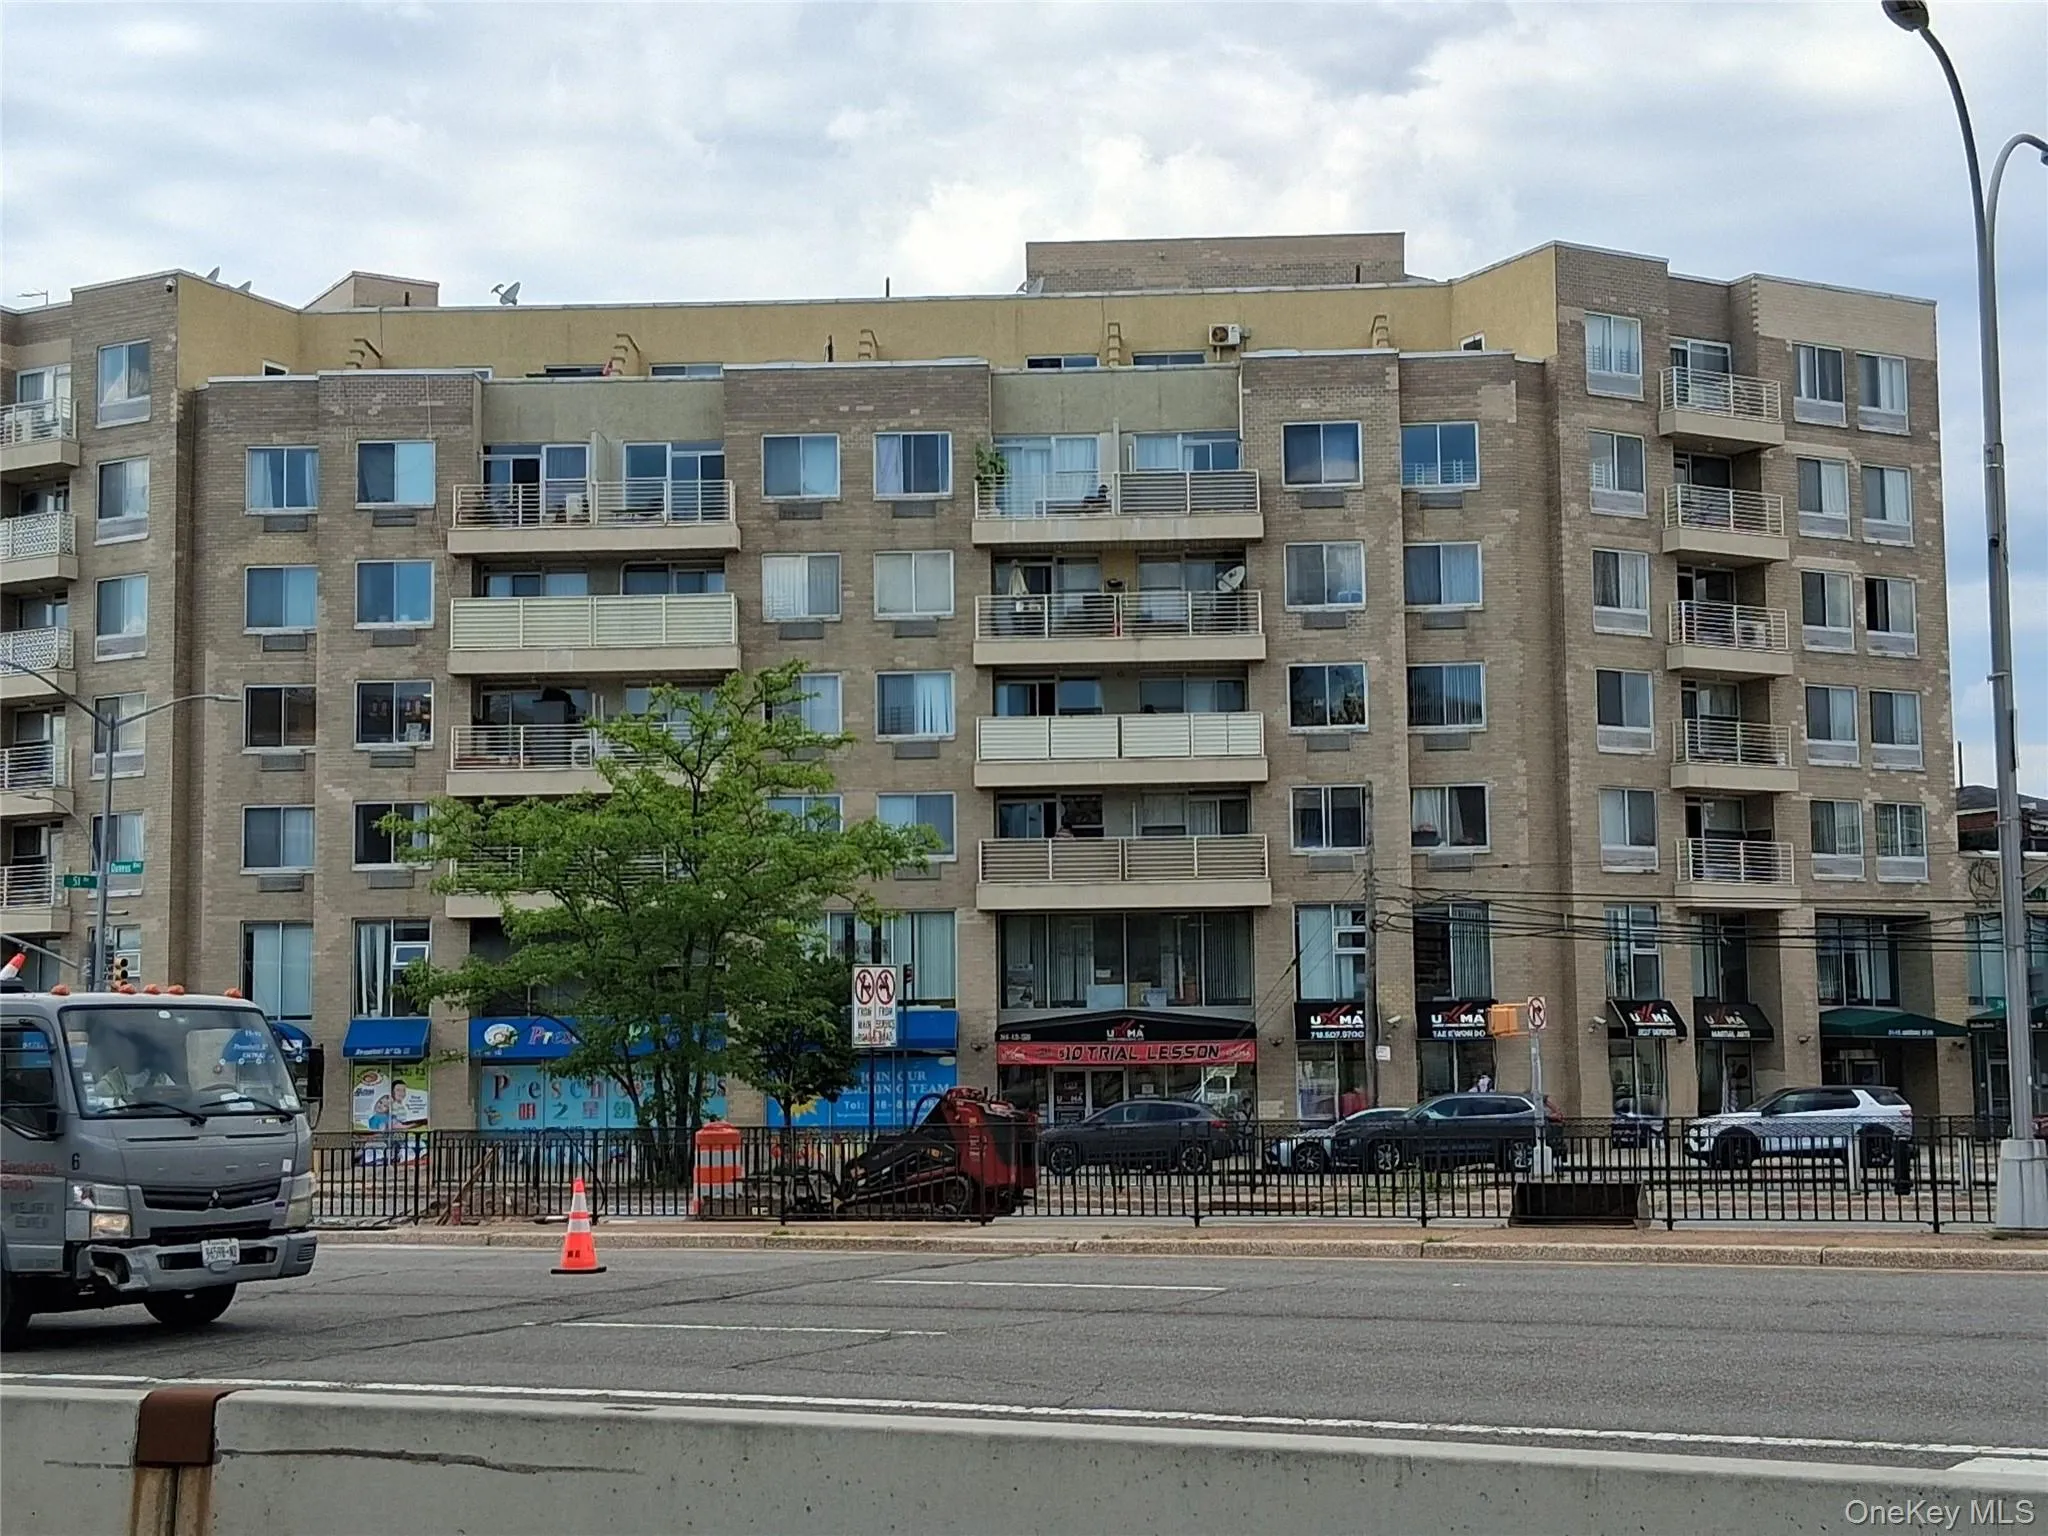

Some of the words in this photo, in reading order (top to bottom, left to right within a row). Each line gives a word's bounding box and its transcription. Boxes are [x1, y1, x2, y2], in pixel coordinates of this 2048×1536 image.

[1087, 1045, 1138, 1061] TRIAL
[1146, 1044, 1220, 1061] LESSON
[910, 1083, 950, 1095] TEAM
[71, 1152, 81, 1171] 6
